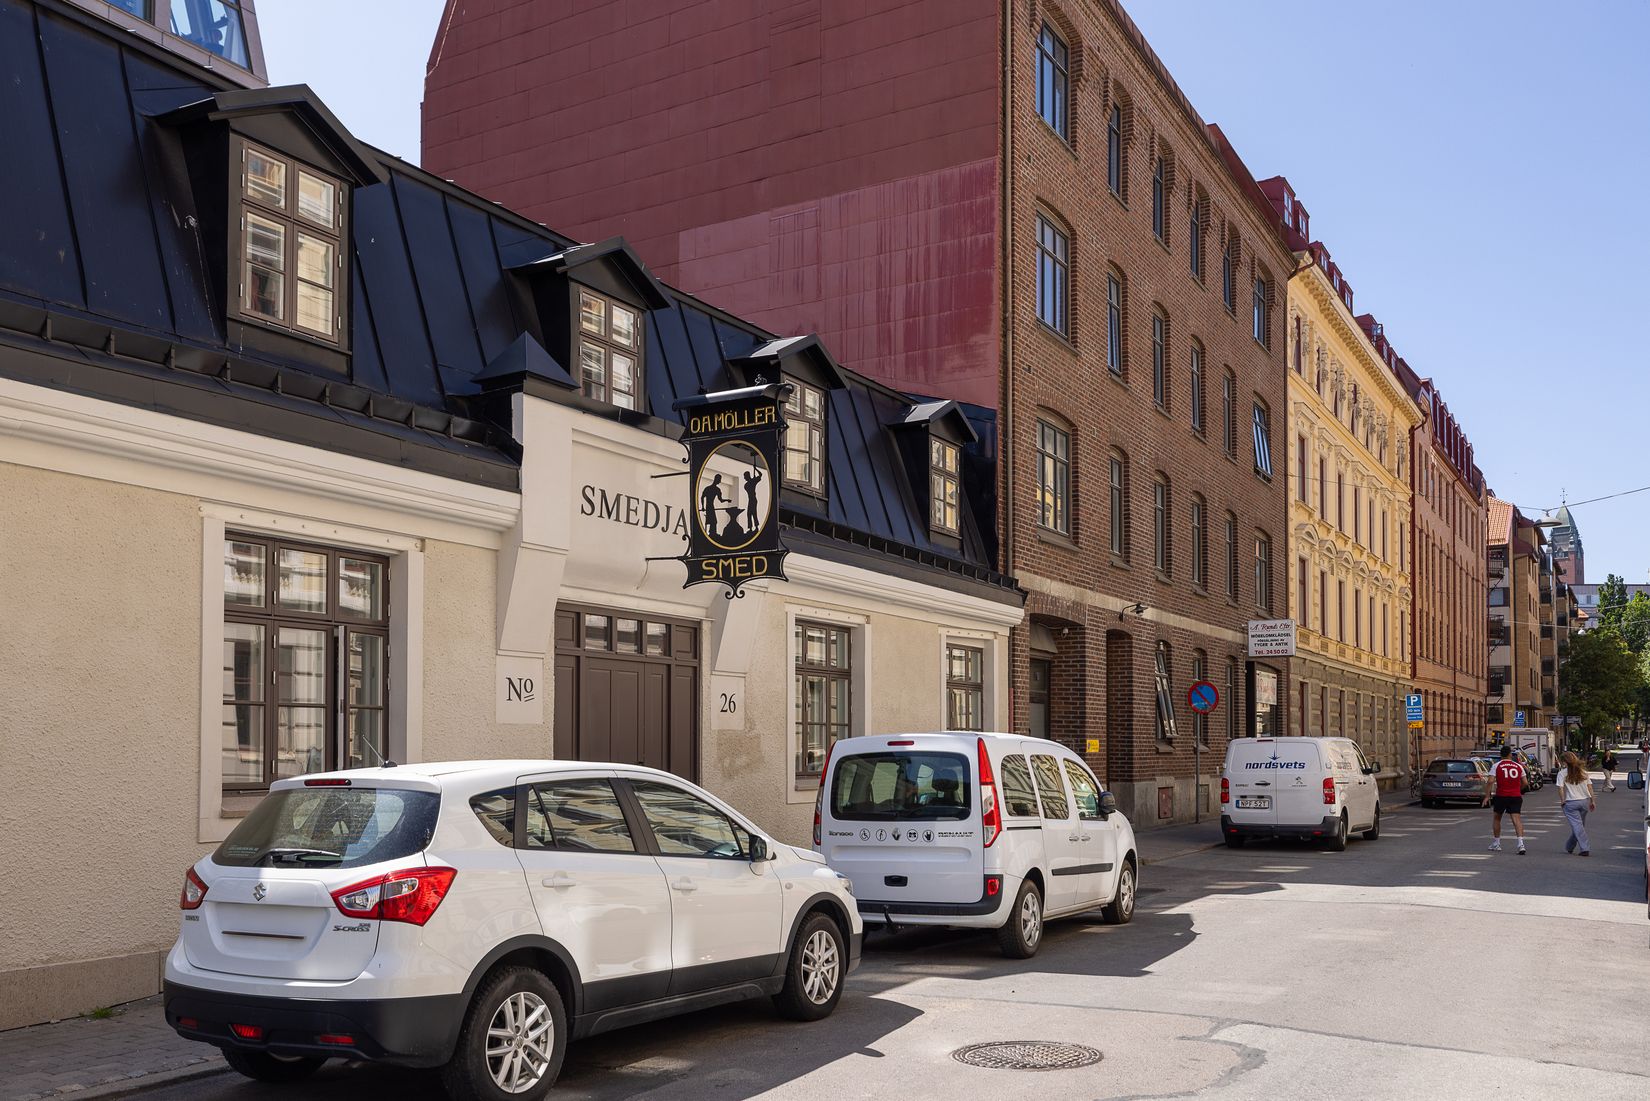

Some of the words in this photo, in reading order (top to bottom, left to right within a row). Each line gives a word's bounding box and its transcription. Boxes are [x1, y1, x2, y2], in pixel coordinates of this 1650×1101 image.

[580, 485, 689, 536] SMEDJA
[701, 556, 768, 579] SMED
[719, 693, 736, 713] 26
[1410, 695, 1419, 706] P
[1245, 760, 1306, 770] nordsvets
[1501, 767, 1518, 779] 10
